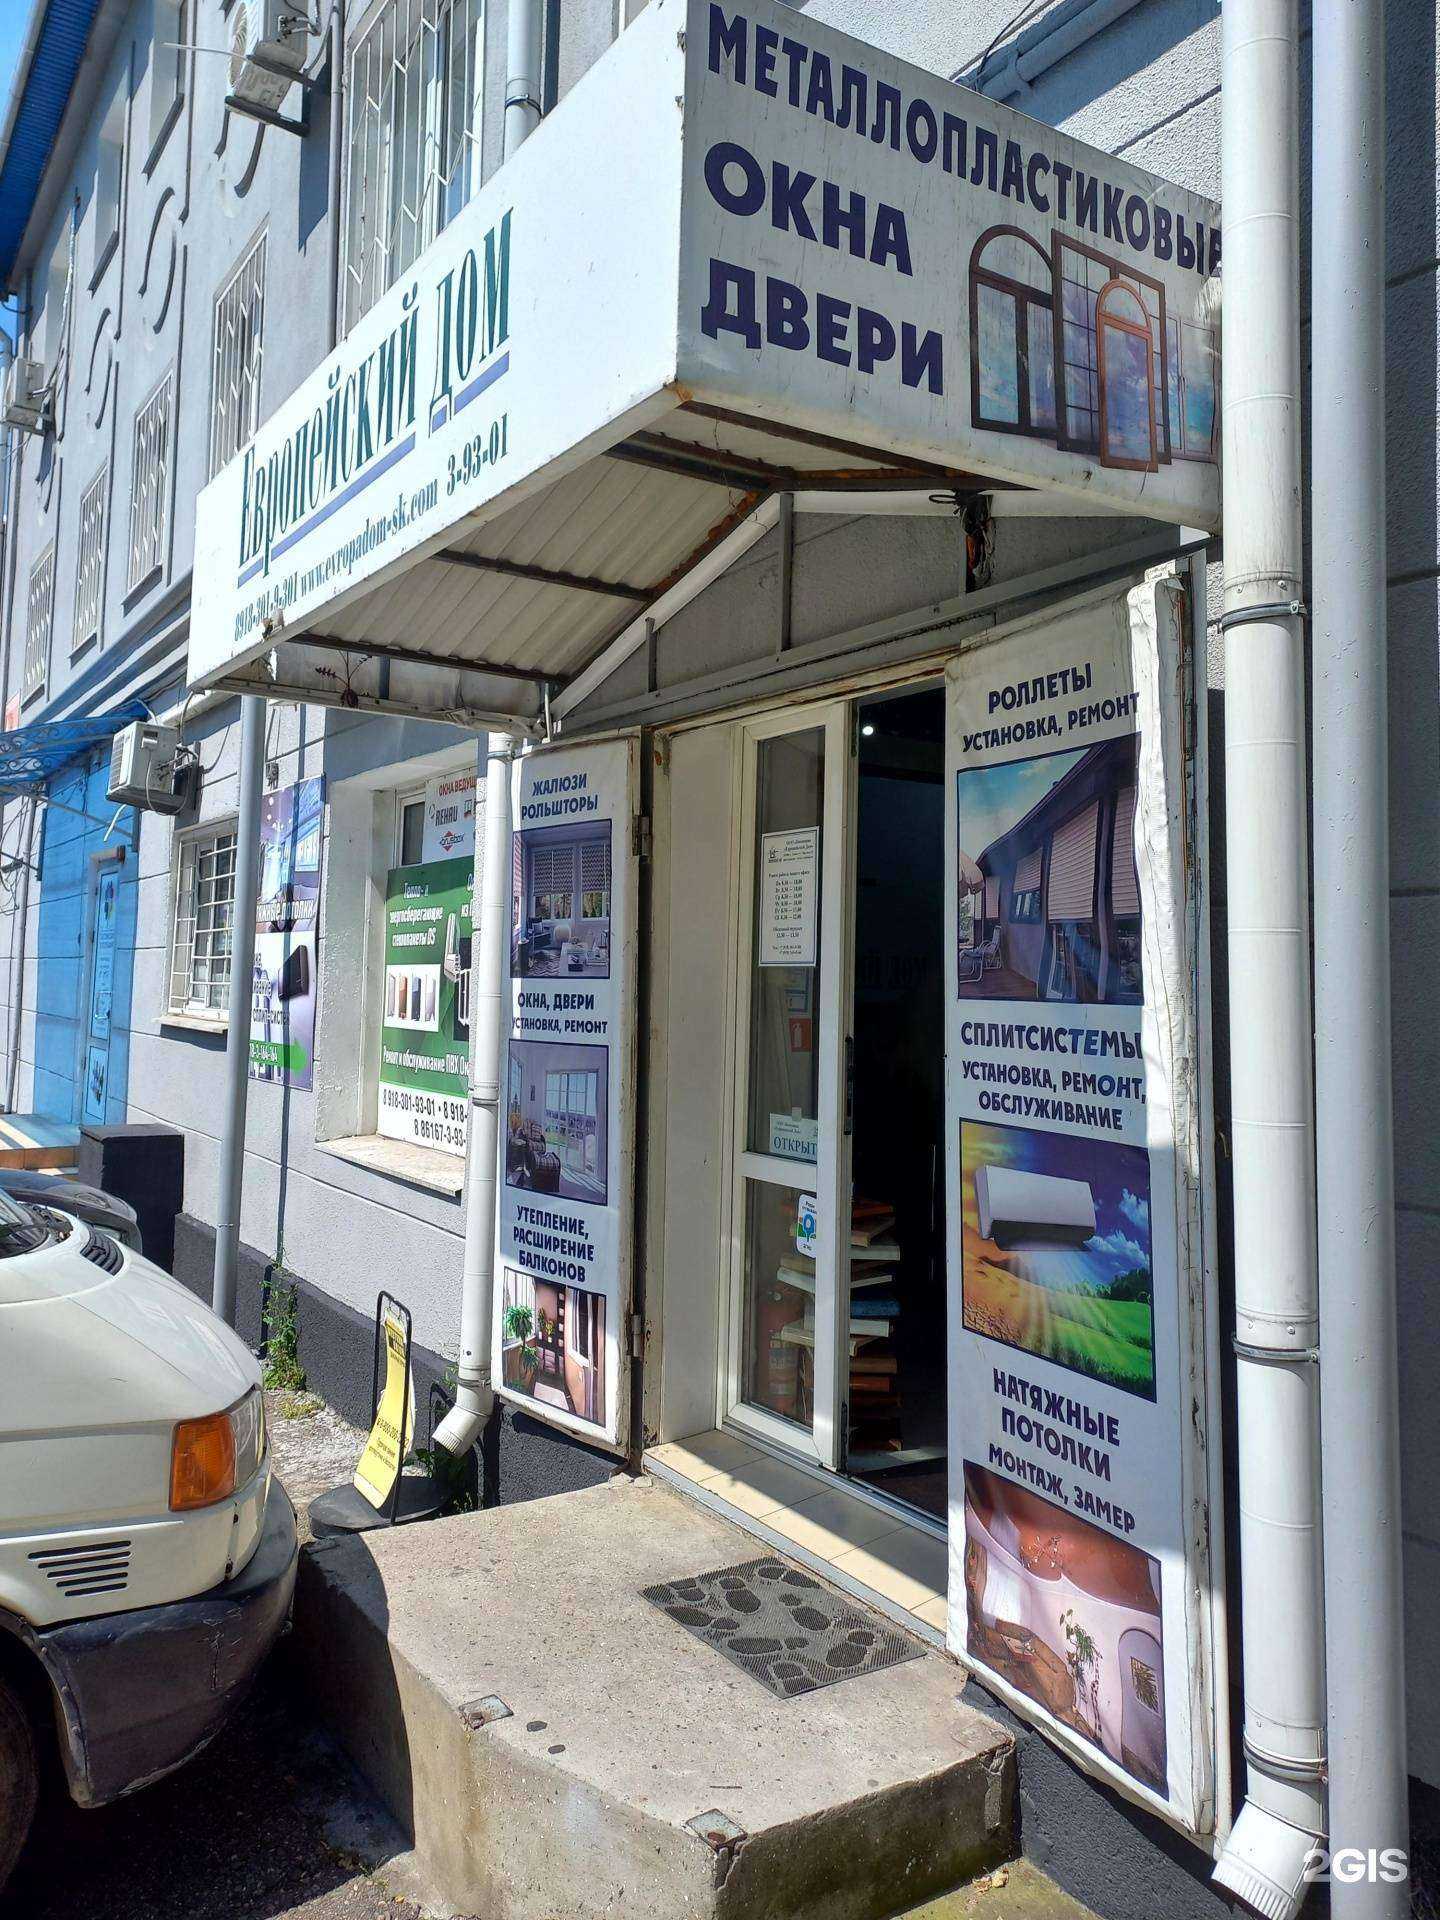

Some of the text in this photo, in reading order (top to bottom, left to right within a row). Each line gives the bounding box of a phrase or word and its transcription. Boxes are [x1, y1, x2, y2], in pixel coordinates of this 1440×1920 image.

[704, 142, 913, 277] ОКНА
[701, 258, 943, 396] ДВЕРИ
[239, 281, 420, 579] Европейский
[301, 479, 438, 597] www.evropadom-sk.com
[446, 413, 508, 497] 3-93-01
[988, 662, 1092, 714] РОЛЛЕТЫ
[962, 692, 1140, 753] УСТАНОВКА, РЕМОНТ
[532, 773, 588, 796] ЖАЛЮЗИ
[521, 794, 598, 820] РОЛЬШТОРЫ
[517, 992, 595, 1011] ОКНА, ДВЕРИ
[512, 1017, 608, 1034] УСТАНОВКА, РЕМОНТ
[960, 1021, 1143, 1059] СПЛИТСИСТЕМЫ
[446, 1054, 459, 1075] ПВХ
[962, 1060, 1146, 1104] УСТАНОВКА, РЕМОНТ,
[383, 1089, 387, 1105] 8
[388, 1089, 435, 1116] 918-301-93-01
[443, 1101, 449, 1119] 8
[978, 1090, 1123, 1130] ОБСЛУЖИВАНИЕ
[414, 1118, 419, 1136] 8
[516, 1205, 589, 1240] УТЕПЛЕНИЕ,
[513, 1226, 595, 1261] РАСШИРЕНИЕ
[518, 1249, 586, 1283] БАЛКОНОВ
[993, 1367, 1120, 1446] НАТЯЖНЫЕ
[1001, 1406, 1111, 1482] ПОТОЛКИ
[988, 1443, 1136, 1534] МОНТАЖ, ЗАМЕР
